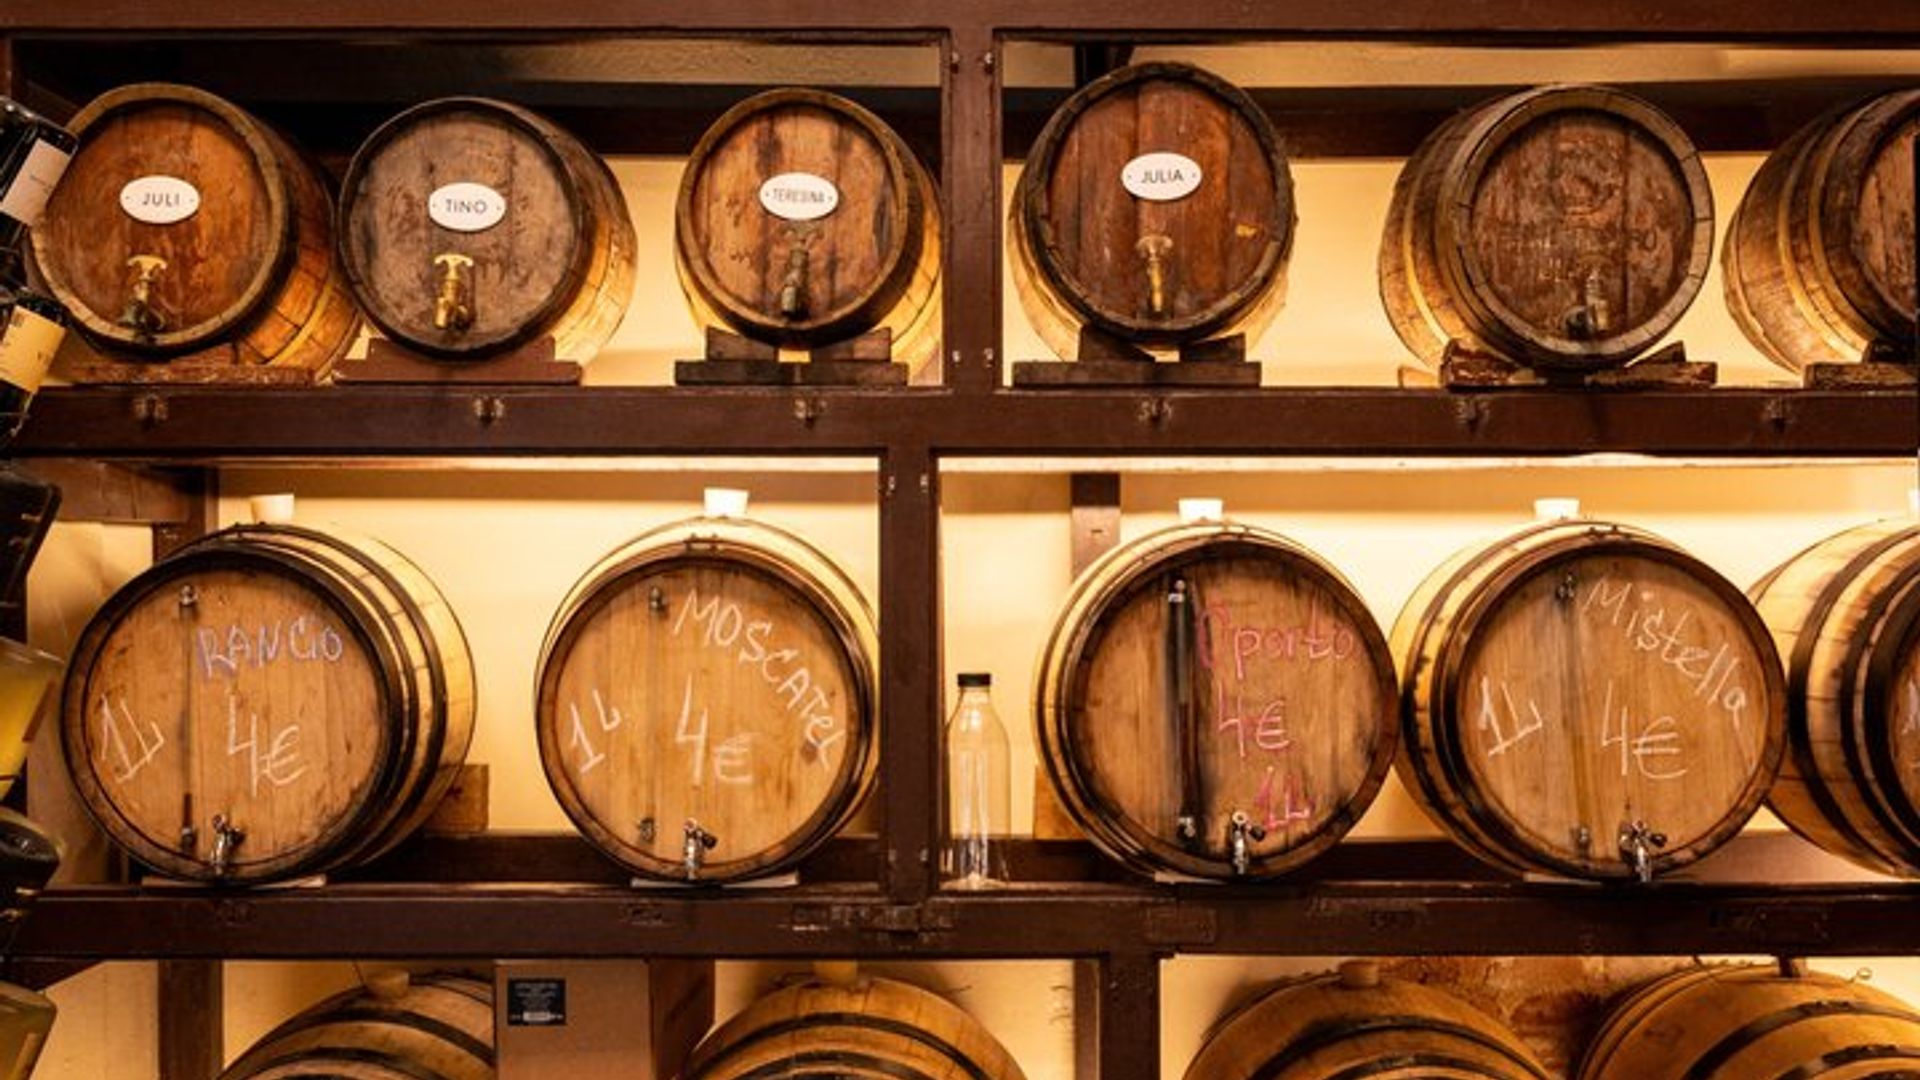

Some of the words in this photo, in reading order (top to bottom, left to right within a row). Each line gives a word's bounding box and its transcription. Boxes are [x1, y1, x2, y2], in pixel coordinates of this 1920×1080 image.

[142, 192, 181, 208] JULI
[445, 198, 488, 214] TINO
[1141, 168, 1184, 185] JULIA
[100, 694, 165, 784] 1L
[227, 693, 306, 798] 4€
[569, 688, 622, 775] 1L
[674, 671, 756, 786] 4€
[1218, 680, 1290, 758] 4€
[1478, 675, 1543, 758] 1L
[1601, 679, 1688, 779] 4€
